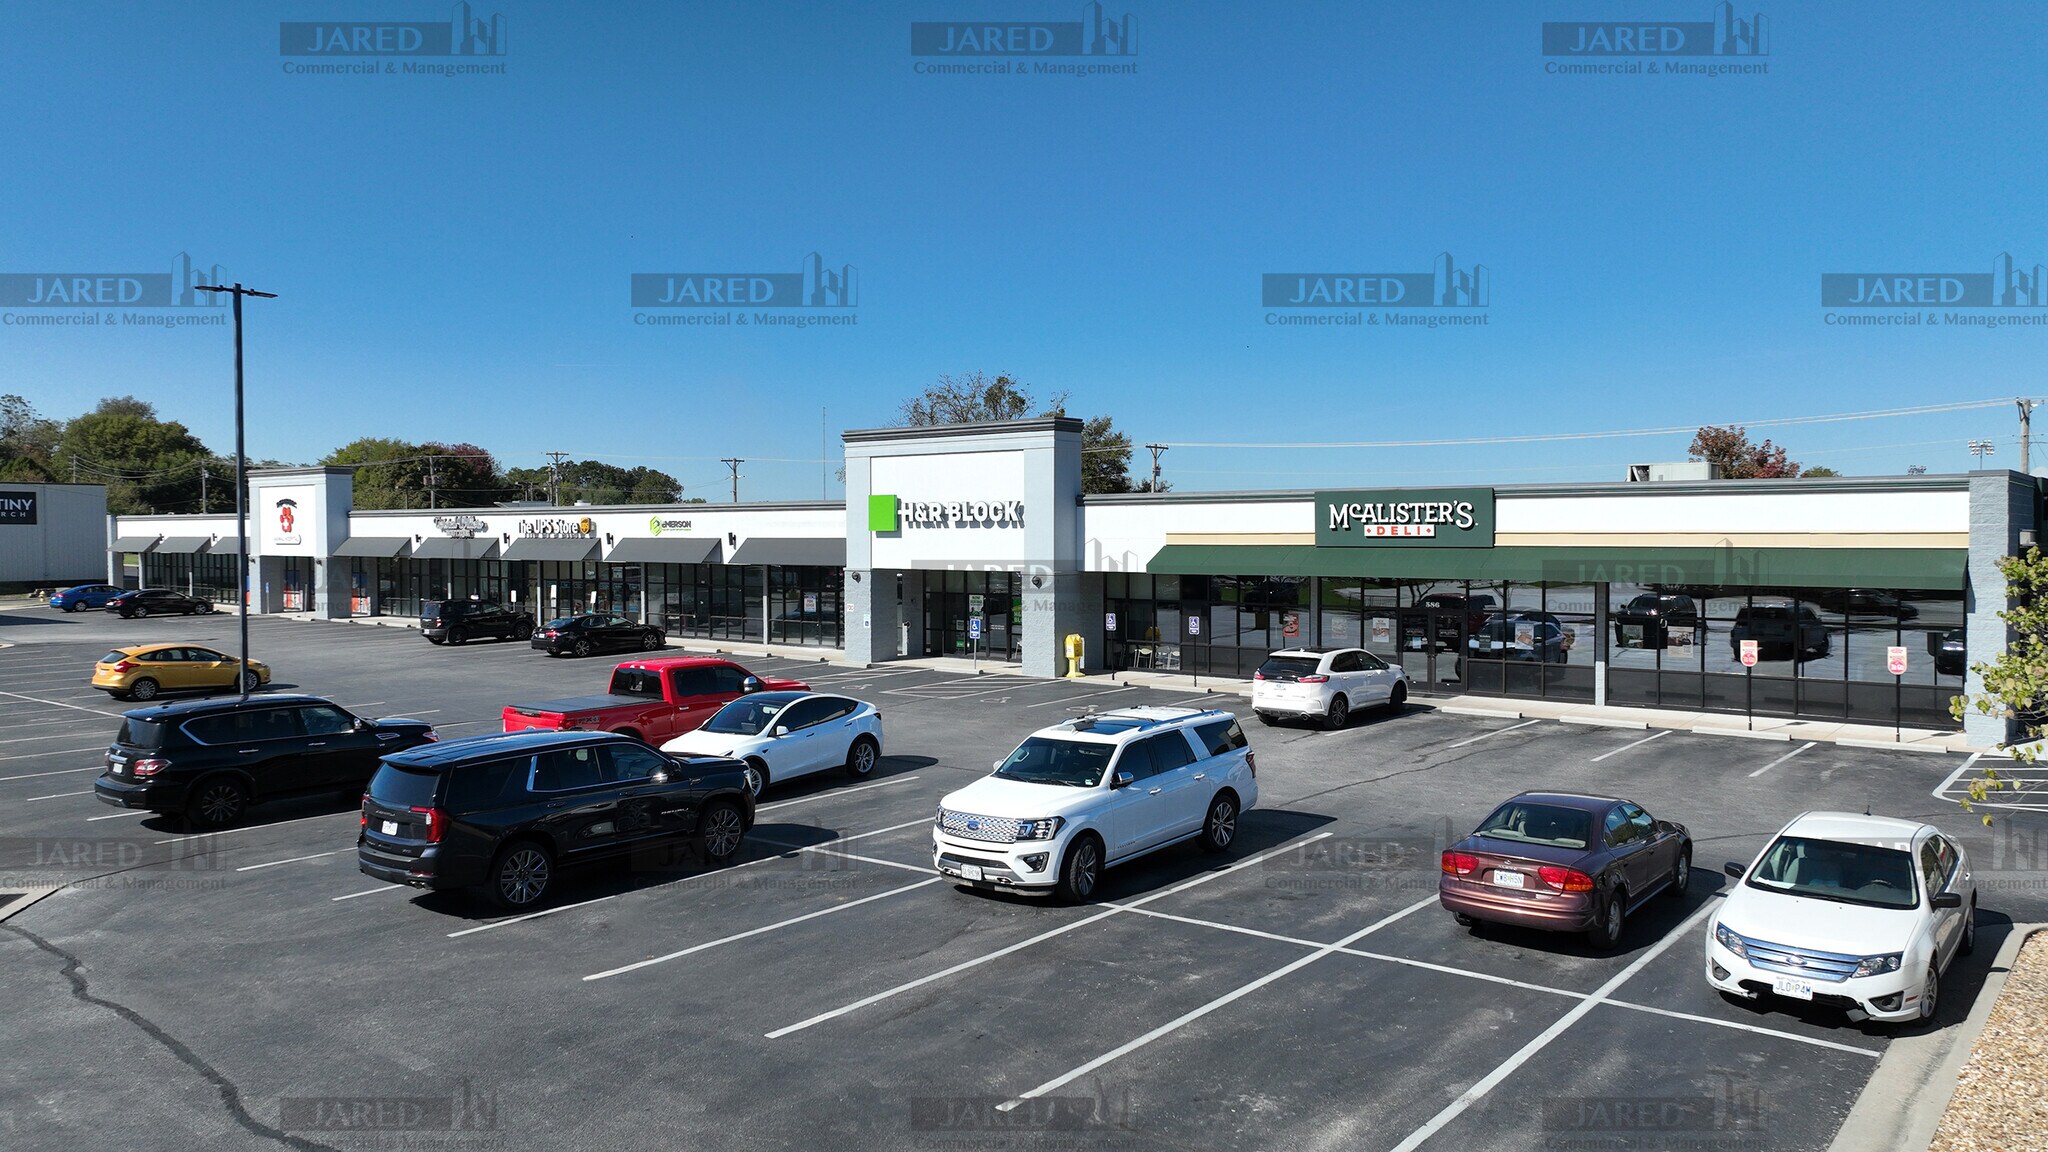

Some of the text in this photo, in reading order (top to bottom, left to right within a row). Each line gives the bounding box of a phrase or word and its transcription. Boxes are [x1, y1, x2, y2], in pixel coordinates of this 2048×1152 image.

[902, 501, 1020, 522] H&R BLOCK
[1376, 526, 1421, 535] DELI
